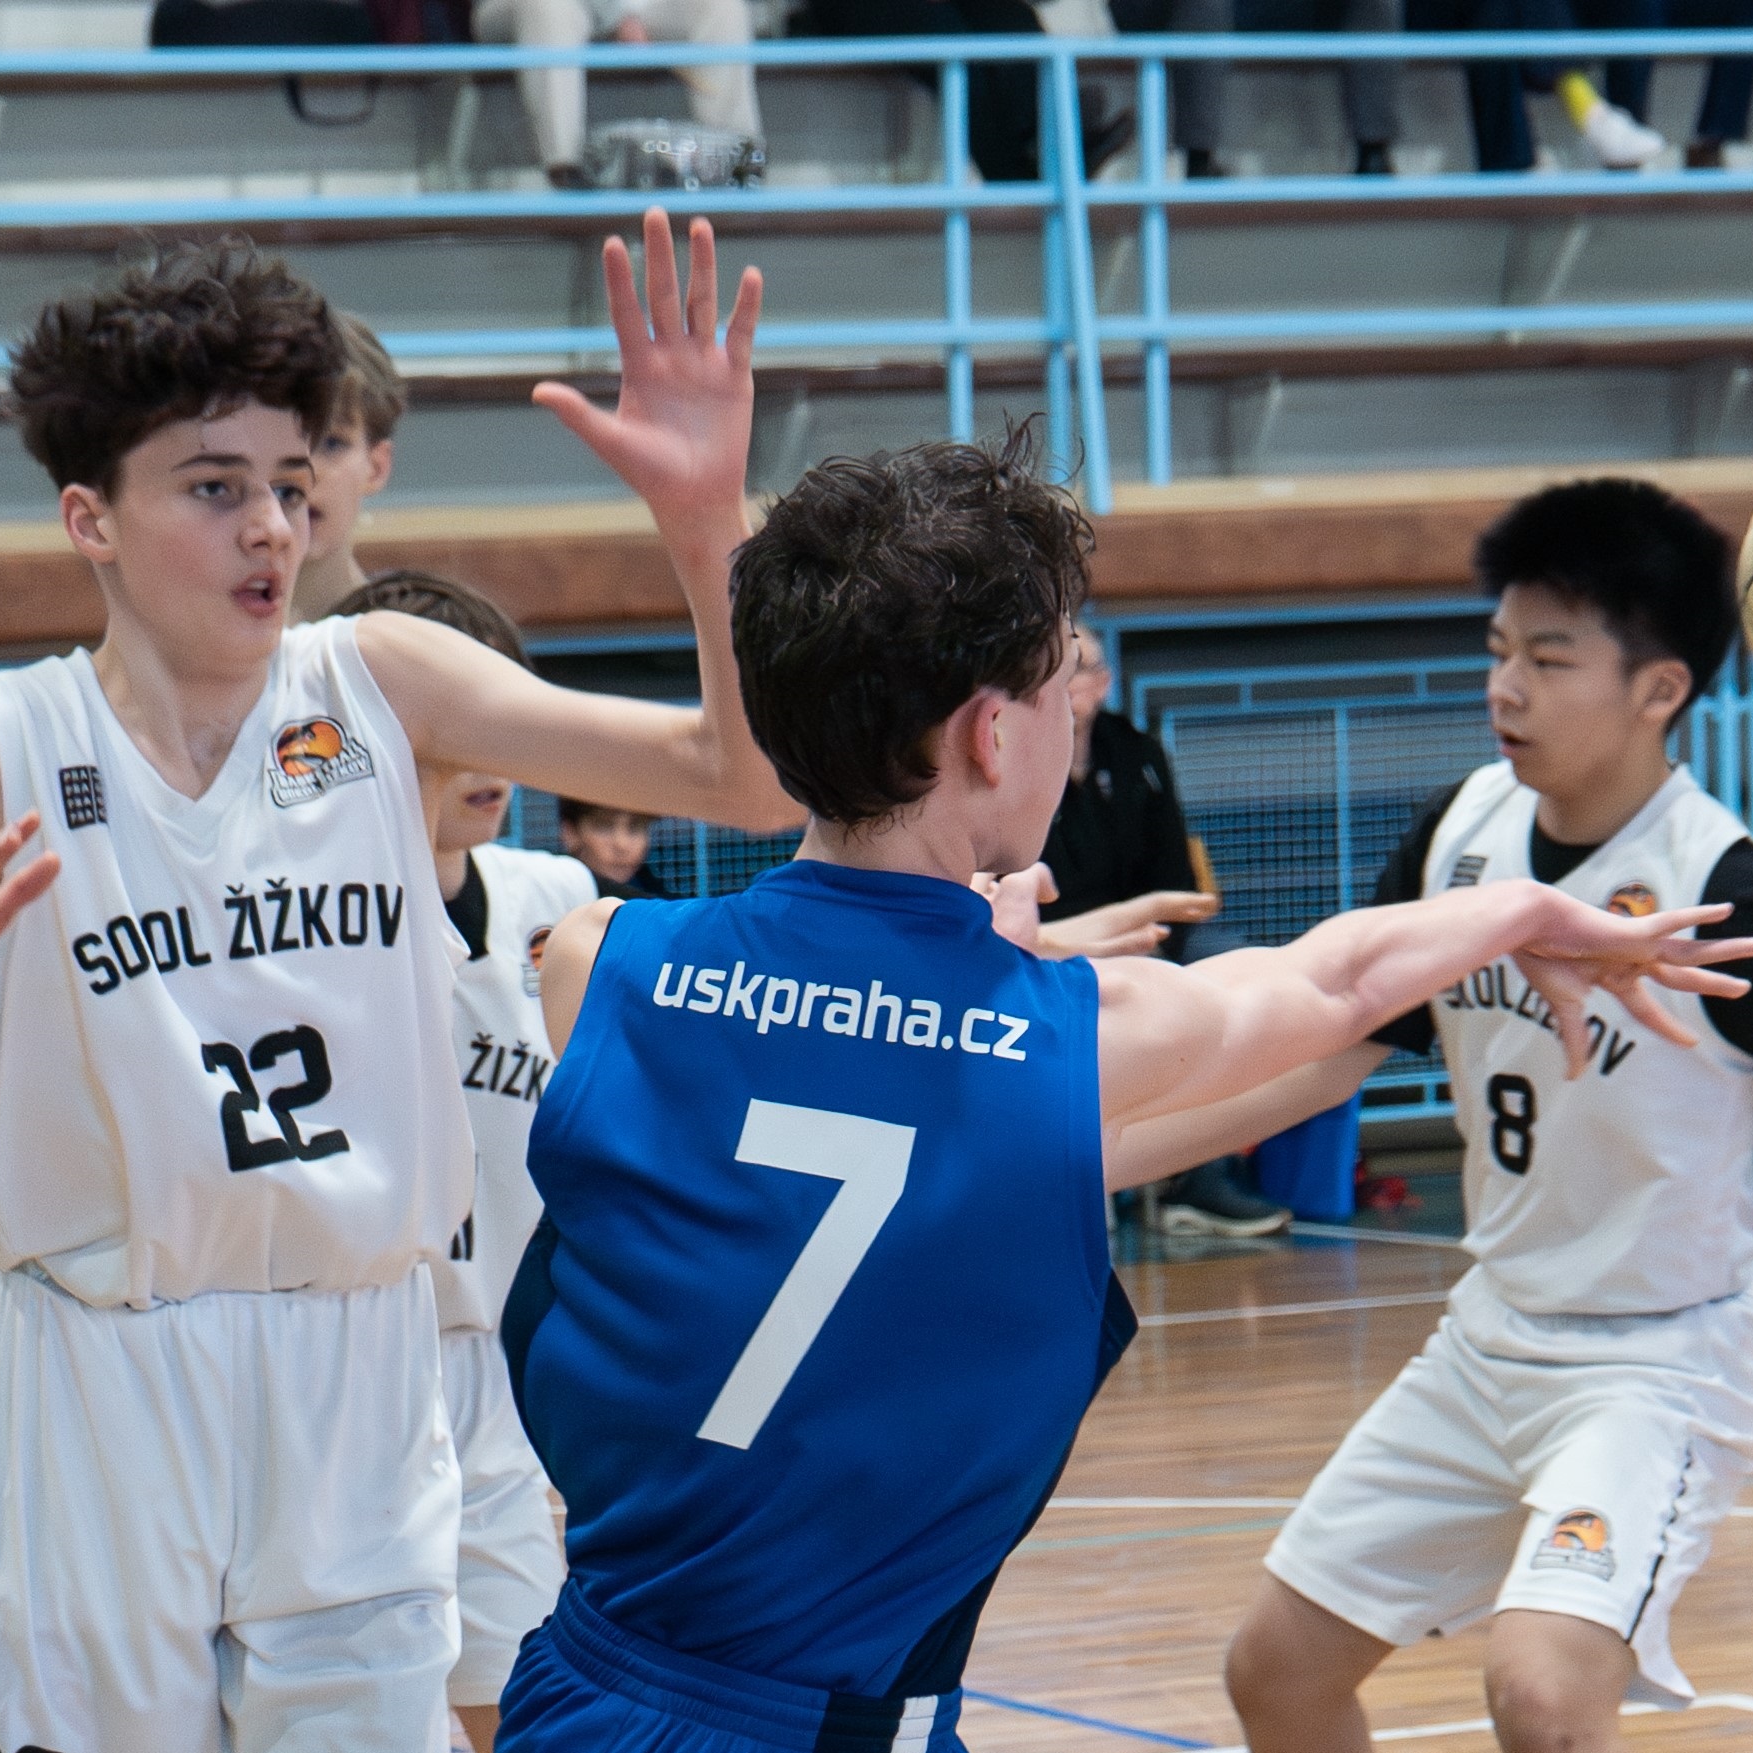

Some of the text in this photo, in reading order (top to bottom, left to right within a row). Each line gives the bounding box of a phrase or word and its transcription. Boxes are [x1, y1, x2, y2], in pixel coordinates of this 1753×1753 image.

[72, 877, 403, 996] SOOL ŽIŽKOV
[652, 960, 1030, 1062] uskpraha.cz
[201, 1024, 351, 1173] 22
[462, 1032, 549, 1102] ŽIŽK
[1487, 1073, 1536, 1176] 8
[696, 1098, 917, 1450] 7
